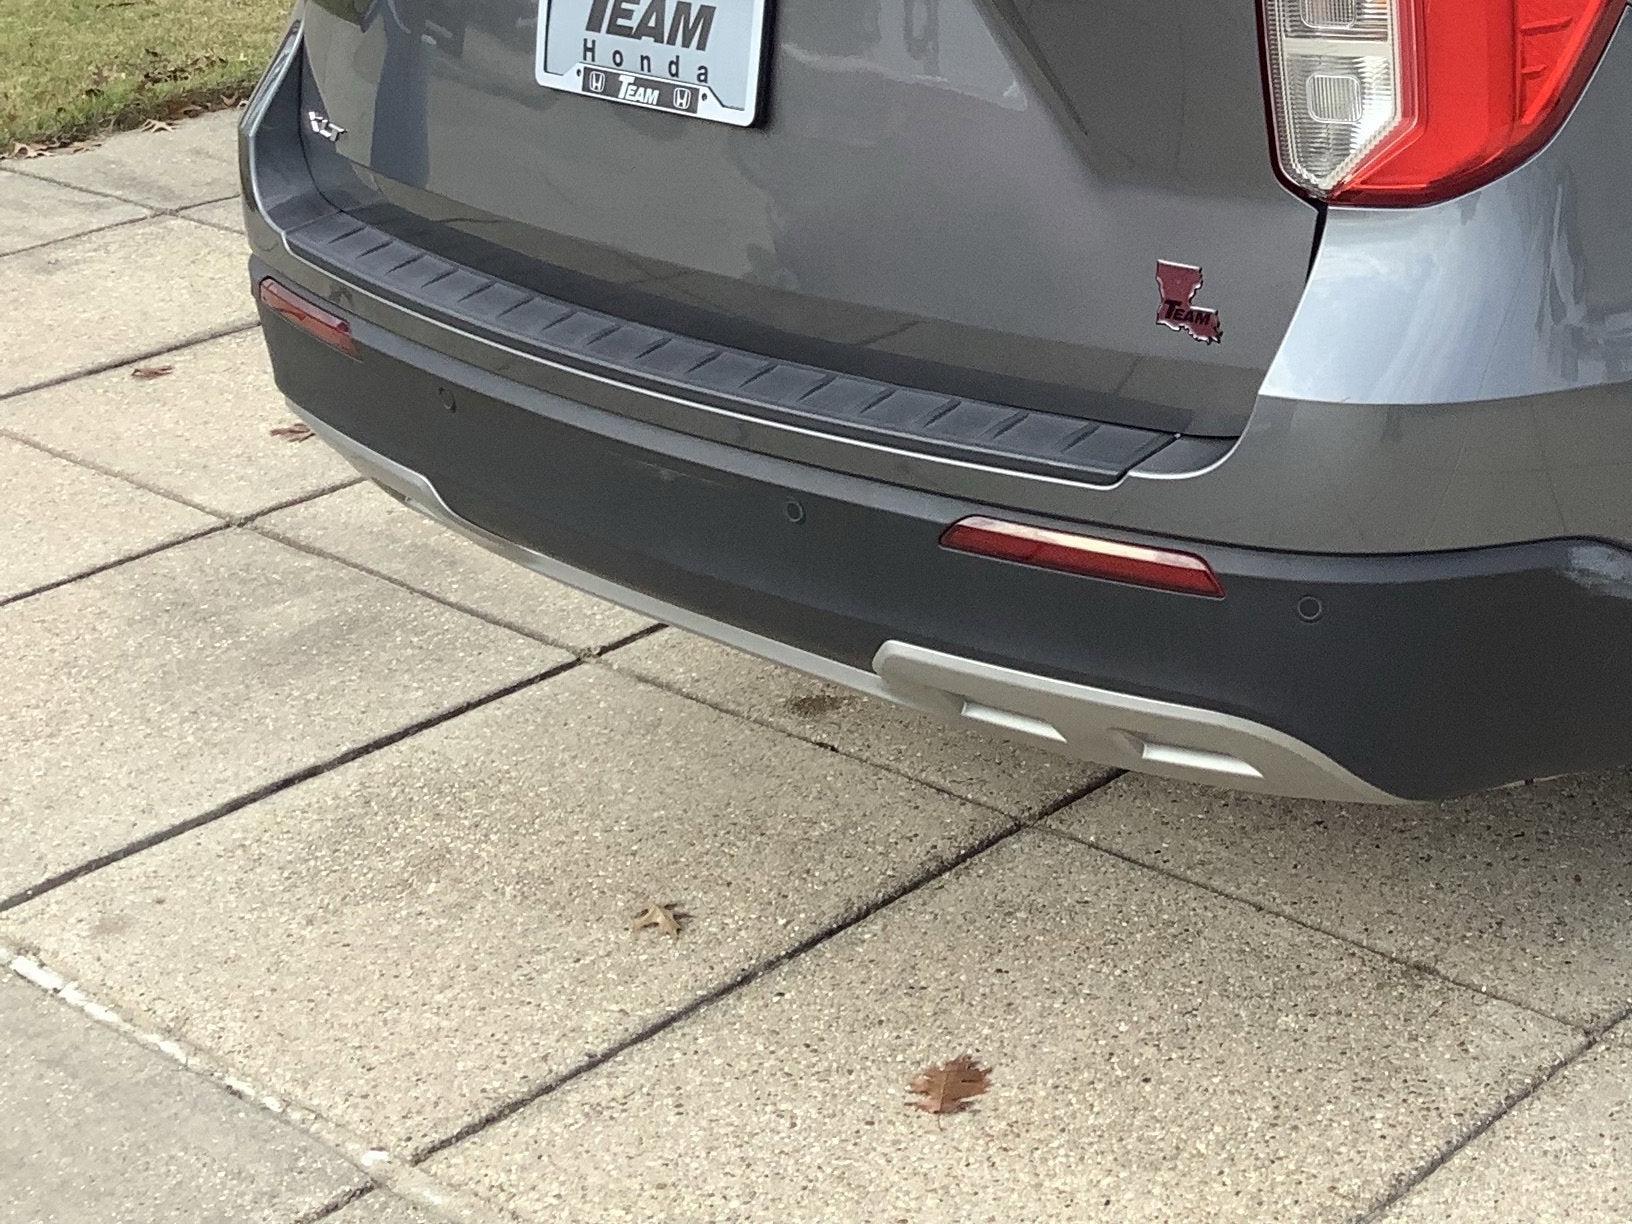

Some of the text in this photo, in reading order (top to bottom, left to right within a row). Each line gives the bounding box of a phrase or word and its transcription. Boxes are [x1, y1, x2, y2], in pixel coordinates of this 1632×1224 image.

[583, 38, 709, 84] Honda
[618, 75, 660, 106] TEAM
[1164, 299, 1212, 326] TEAM
